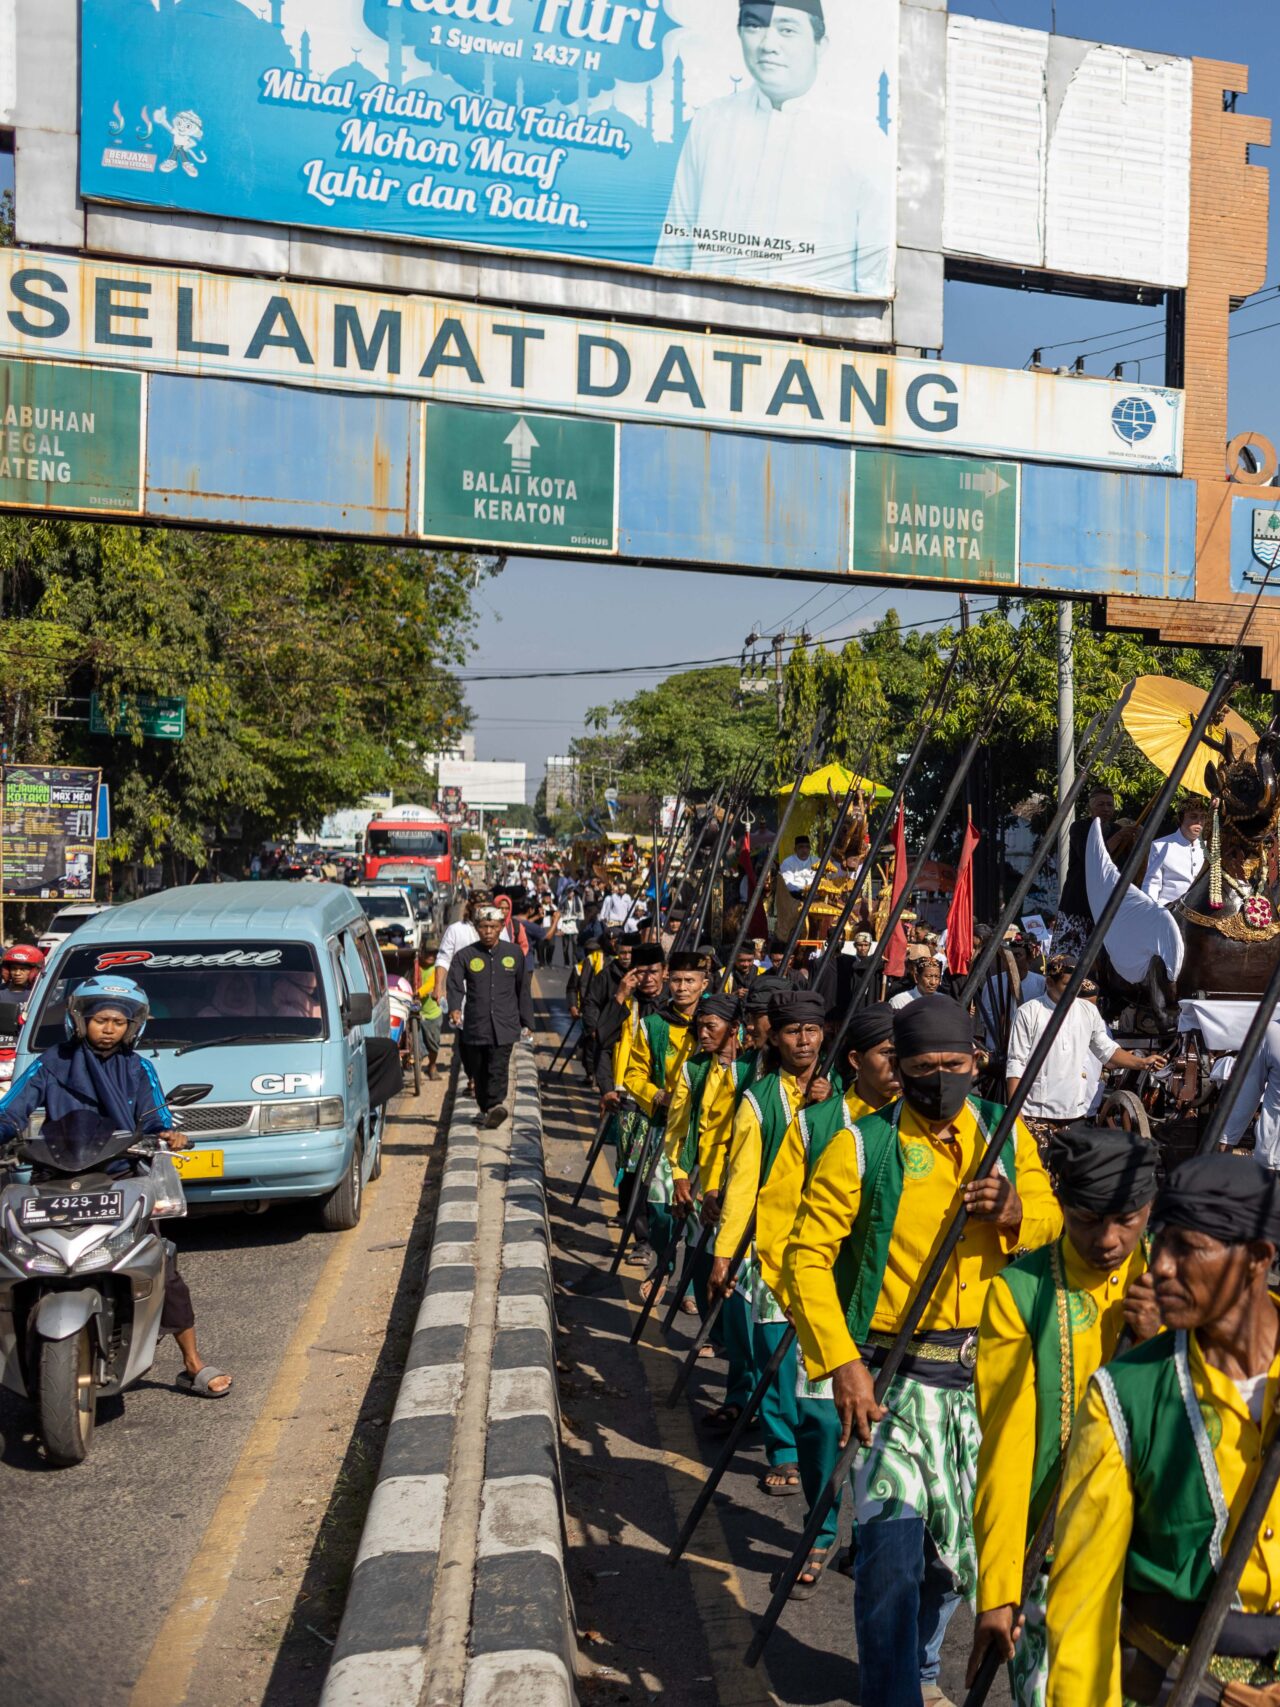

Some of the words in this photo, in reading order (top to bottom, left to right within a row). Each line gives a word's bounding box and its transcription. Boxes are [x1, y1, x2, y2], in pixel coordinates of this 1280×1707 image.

[430, 25, 442, 45] 1
[446, 27, 523, 59] Syawal
[531, 42, 578, 66] 1437
[584, 50, 601, 71] H
[263, 68, 355, 108] Minal
[359, 84, 444, 122] Aidin
[451, 96, 517, 132] Wal
[520, 106, 631, 153] Faidzin,
[340, 118, 460, 167] Mohon
[470, 136, 567, 189] Maaf
[303, 159, 401, 207] Lahir
[406, 175, 477, 214] dan
[485, 183, 588, 228] Batin.
[664, 223, 690, 237] Drs.
[693, 227, 761, 247] NASRUDIN
[763, 237, 796, 253] AZIS,
[798, 242, 815, 254] SH
[697, 243, 743, 256] WALIKOTA
[745, 249, 783, 261] CIREBON
[6, 268, 545, 388] SELAMAT
[576, 333, 959, 432] DATANG
[0, 404, 95, 434] ABUHAN
[462, 469, 521, 495] BALAI
[527, 475, 577, 500] KOTA
[89, 496, 133, 507] DISHUB
[474, 498, 565, 526] KERATON
[887, 501, 985, 532] BANDUNG
[570, 535, 609, 546] DISHUB
[889, 531, 981, 561] JAKARTA
[6, 793, 50, 803] KOTAKU
[27, 1201, 36, 1211] E
[100, 1194, 118, 1206] DJ
